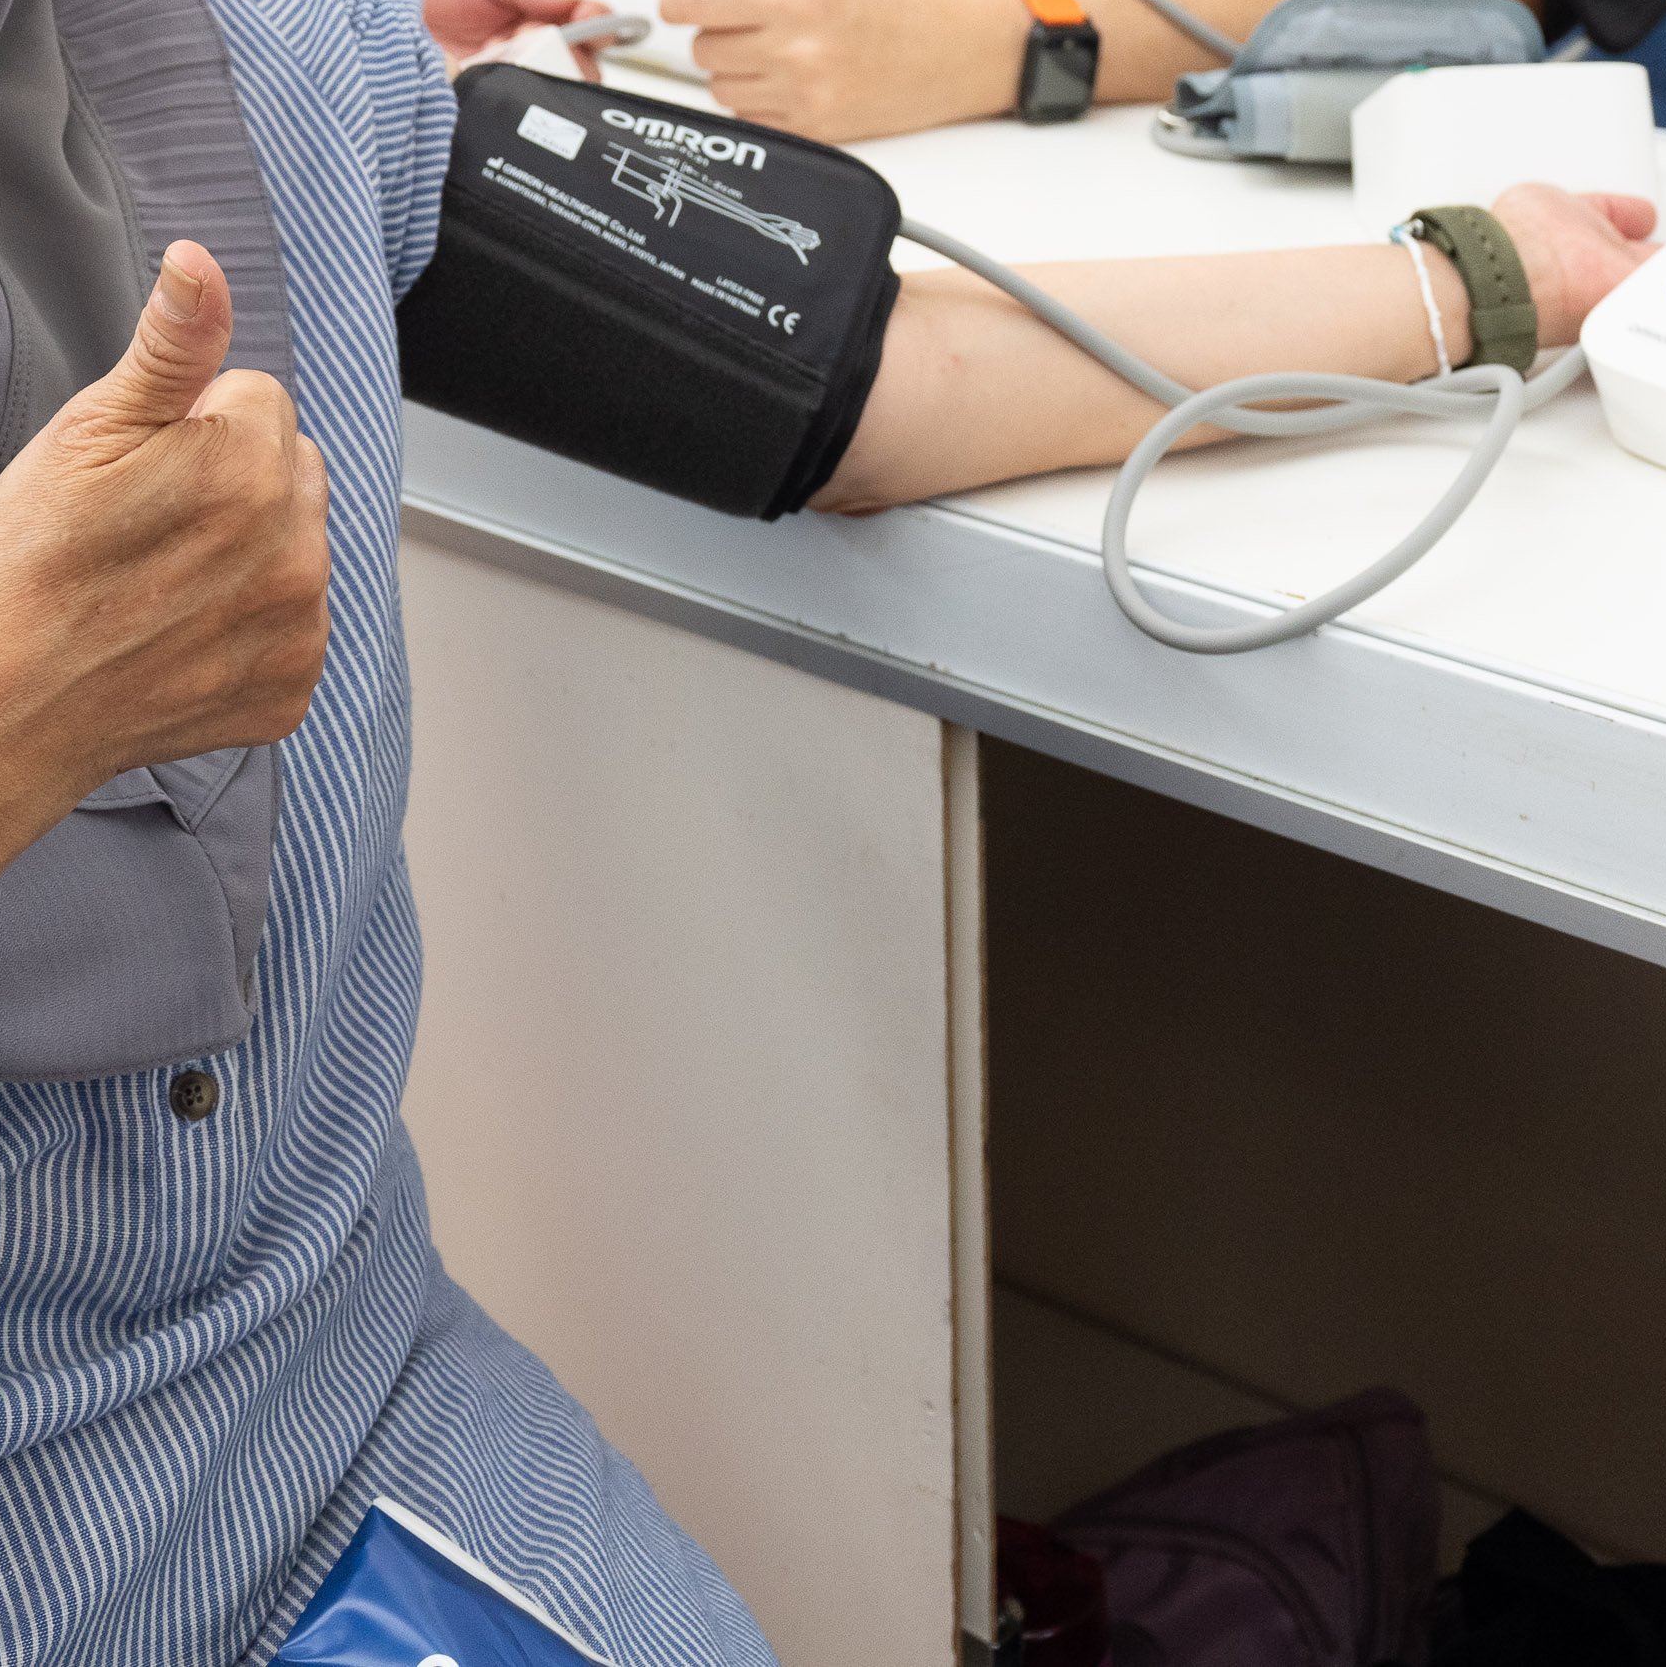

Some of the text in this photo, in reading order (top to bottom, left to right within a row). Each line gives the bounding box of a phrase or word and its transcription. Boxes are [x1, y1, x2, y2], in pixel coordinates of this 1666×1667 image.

[601, 108, 767, 171] OMRON
[502, 162, 544, 191] OMRON
[542, 183, 611, 226] HEALTHCARE
[767, 304, 802, 335] CE
